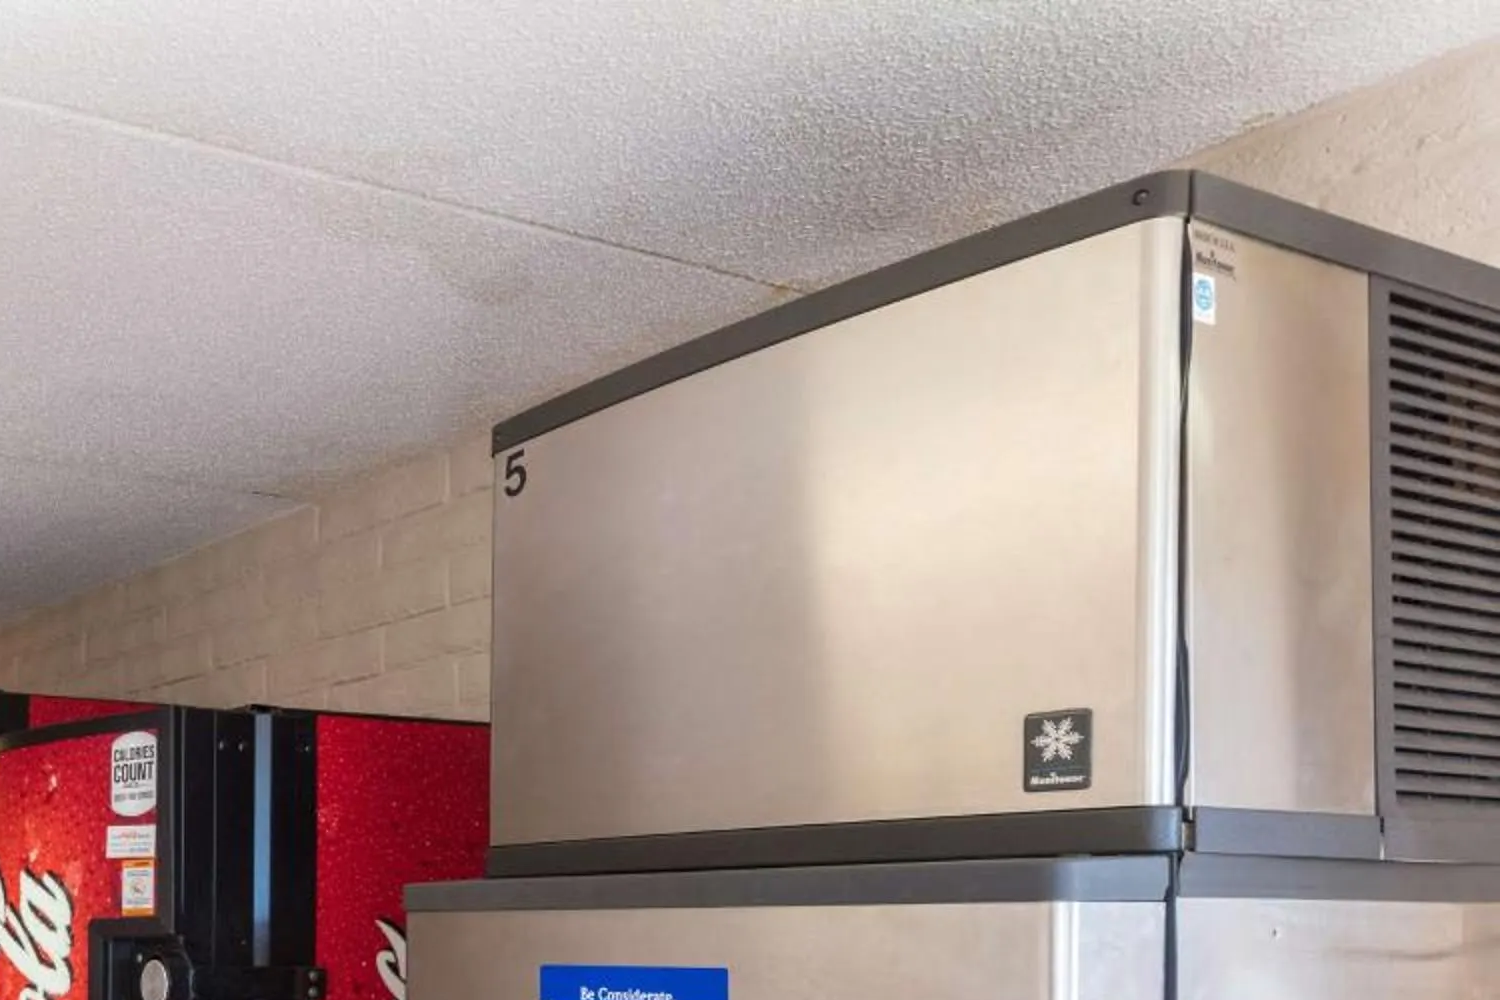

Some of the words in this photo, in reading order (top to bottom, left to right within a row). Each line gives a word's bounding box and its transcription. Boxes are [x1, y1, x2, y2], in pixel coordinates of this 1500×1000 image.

[504, 448, 527, 497] 5
[114, 761, 155, 784] COUNT
[579, 986, 595, 1000] Be
